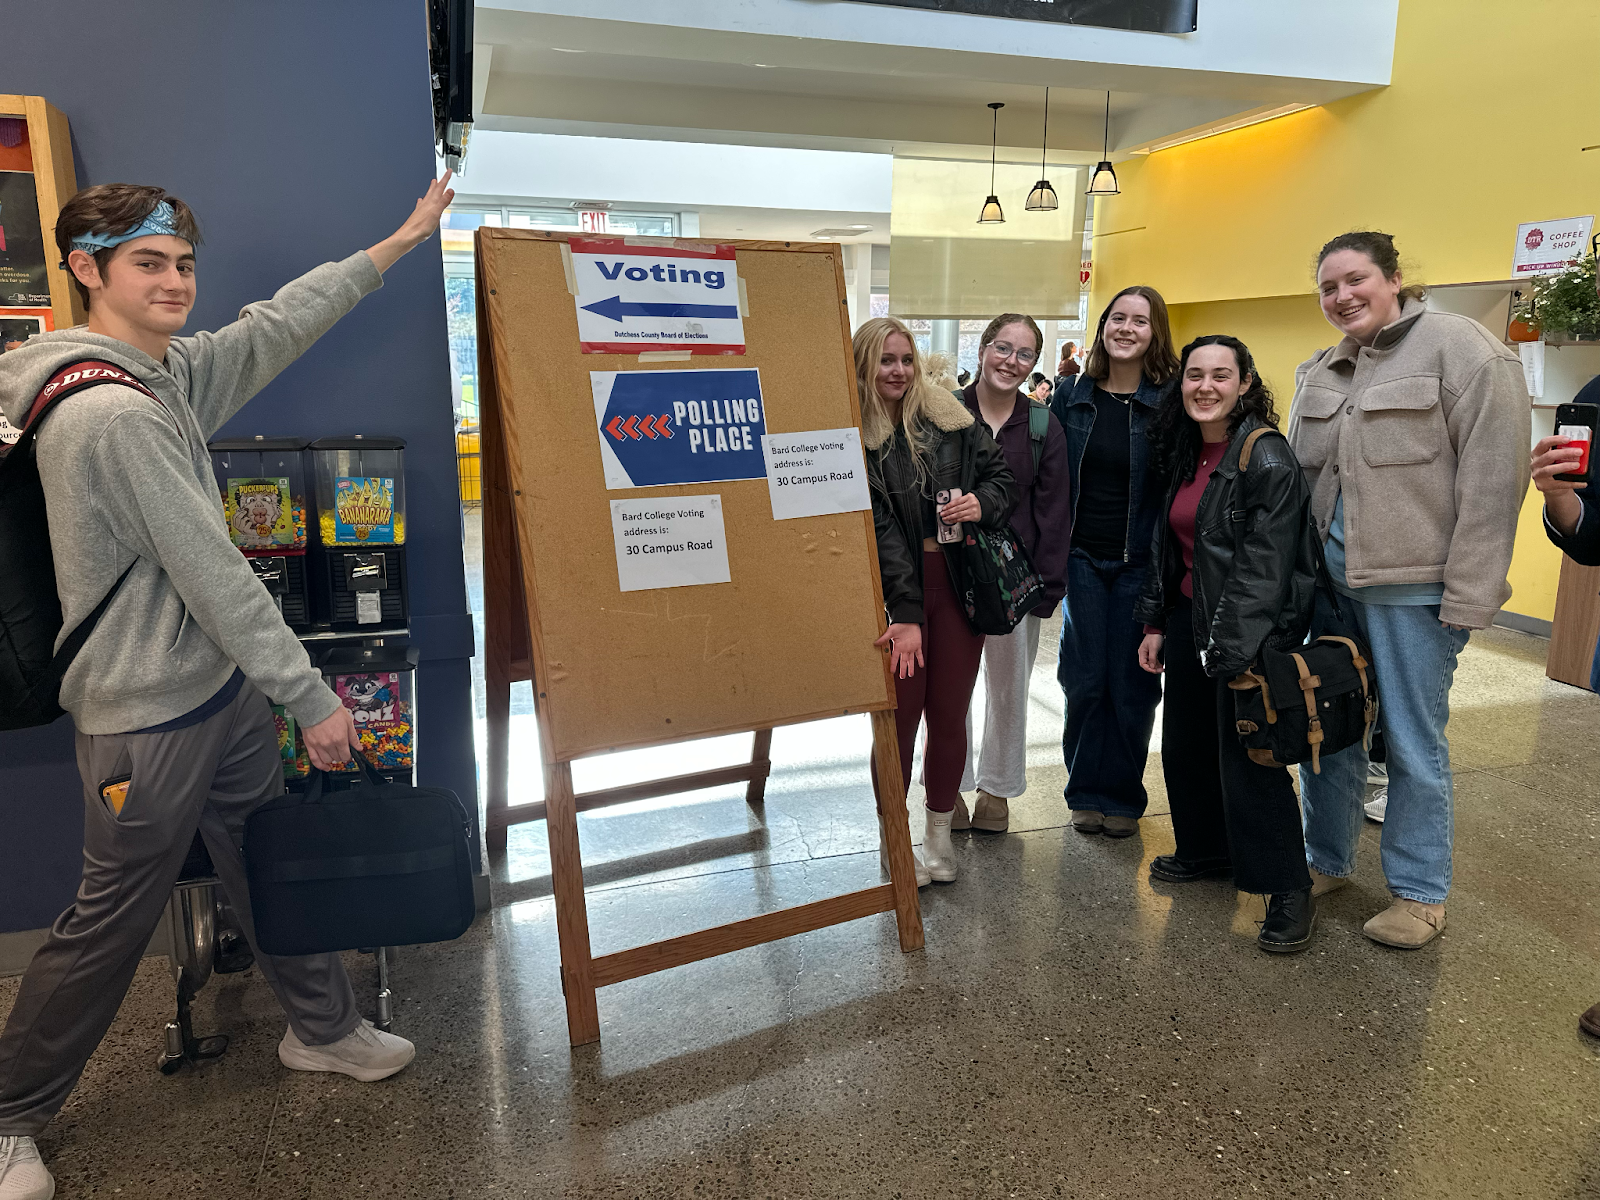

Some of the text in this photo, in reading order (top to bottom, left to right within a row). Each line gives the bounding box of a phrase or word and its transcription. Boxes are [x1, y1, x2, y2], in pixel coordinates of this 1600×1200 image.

[581, 212, 607, 233] EXIT
[1549, 231, 1584, 240] COFFEE
[1552, 241, 1576, 249] SHOP
[594, 260, 726, 290] Voting
[61, 369, 146, 389] DUNL
[673, 398, 760, 426] POLLING
[689, 426, 754, 454] PLACE
[771, 442, 845, 454] Bard College Voting
[774, 458, 814, 468] address is:
[776, 469, 854, 486] 30 Campus Road
[337, 506, 392, 525] BANANARAMA
[622, 509, 705, 521] Bard College Voting
[624, 526, 669, 536] address is:
[626, 540, 714, 555] 30 Campus Road
[367, 721, 396, 729] CANDY
